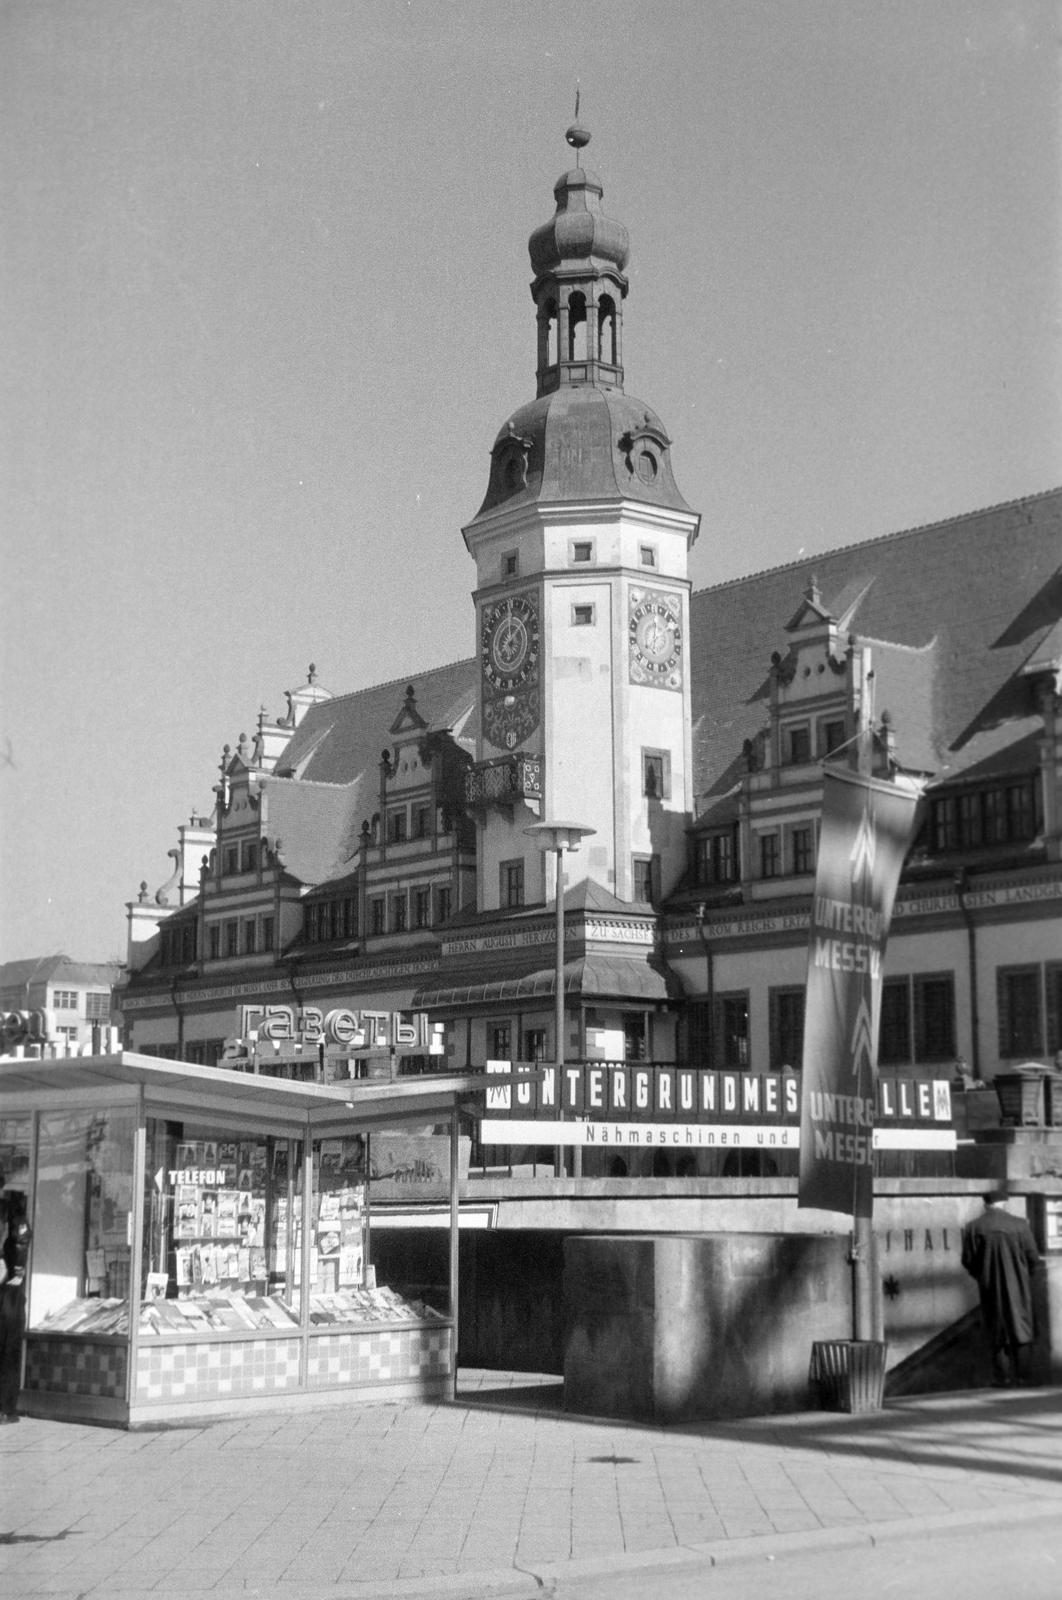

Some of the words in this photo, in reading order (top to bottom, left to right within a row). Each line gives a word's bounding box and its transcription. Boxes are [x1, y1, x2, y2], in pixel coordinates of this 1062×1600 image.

[909, 893, 996, 913] CHURFUSTEN
[447, 941, 477, 954] HERRN
[483, 934, 517, 949] AUGUSTI
[522, 927, 577, 945] HERTZOEN
[591, 926, 607, 938] ZU
[612, 928, 657, 942] SACHSEN
[671, 929, 690, 941] DES
[236, 1004, 429, 1047] газеты
[586, 1124, 741, 1145] Nähmaschinen
[757, 1129, 788, 1146] und
[168, 1170, 226, 1186] TELEFON
